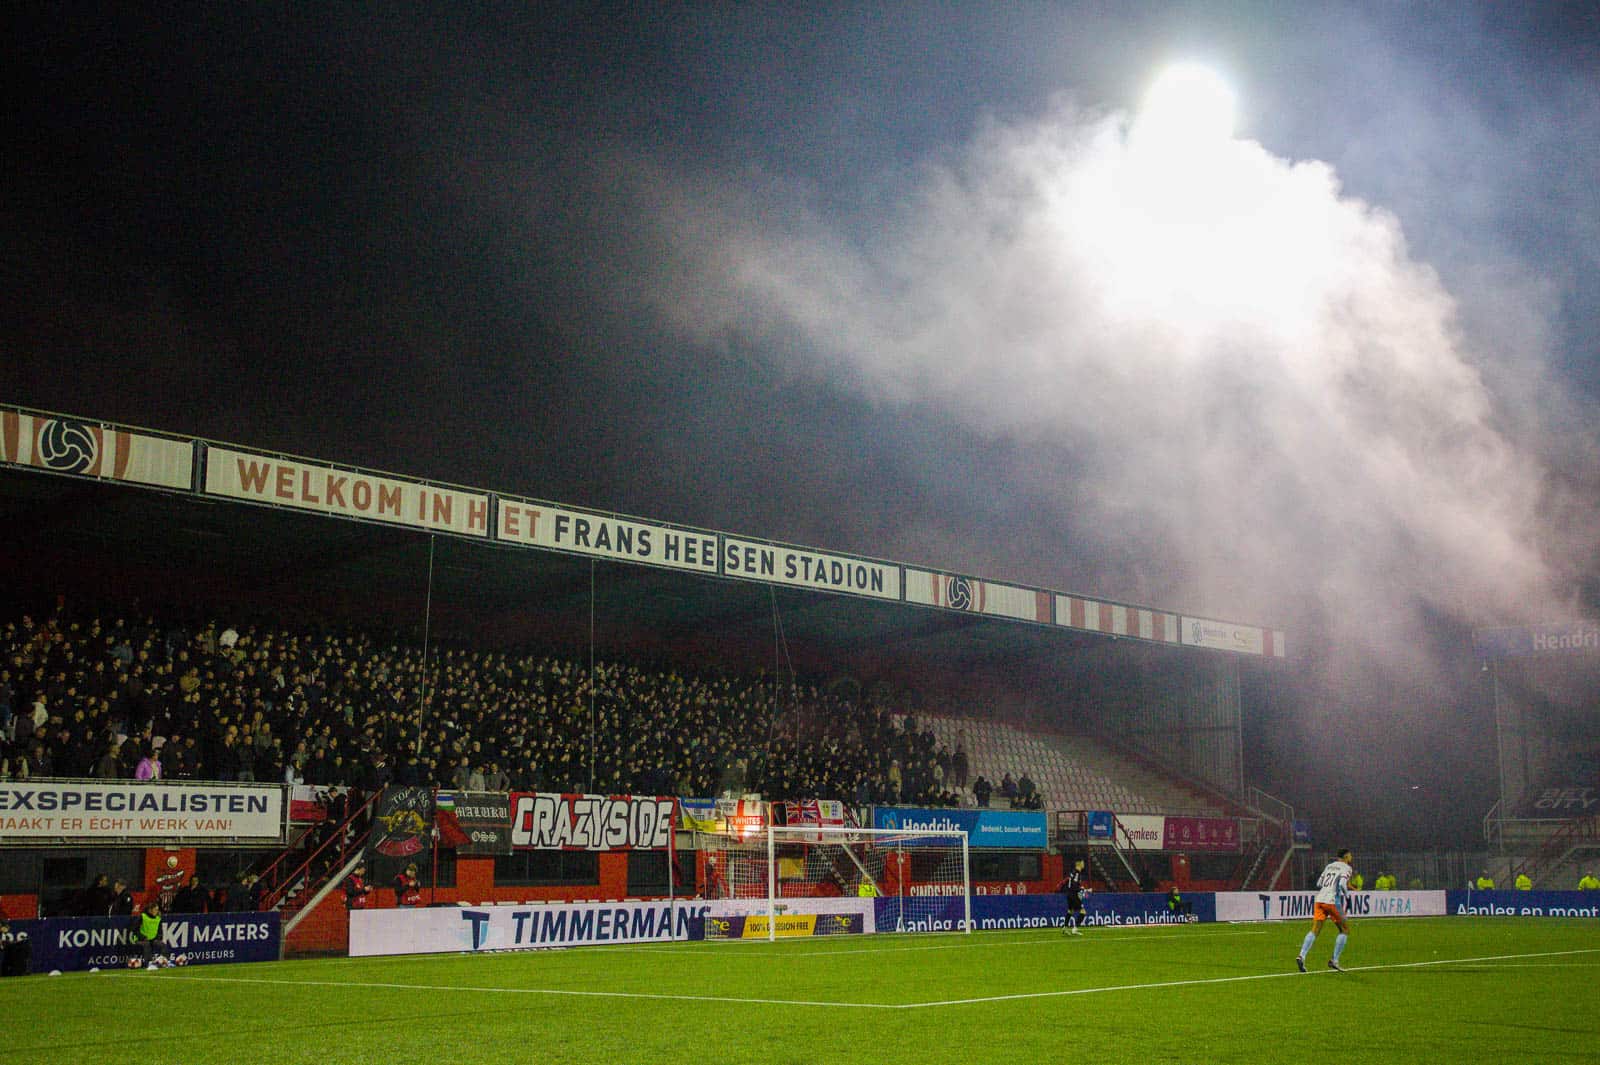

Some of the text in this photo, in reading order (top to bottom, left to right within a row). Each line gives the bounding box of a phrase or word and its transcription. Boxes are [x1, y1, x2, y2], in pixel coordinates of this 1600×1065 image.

[237, 457, 884, 593] WELKOM IN HET FRANS HEESEN STADION
[0, 790, 268, 813] EXSPECIALISTEN
[455, 806, 508, 818] MALUKU
[0, 815, 232, 831] AAKT ER ÉCHT WERK VAN!
[512, 799, 674, 848] CRAZYSIDE
[1323, 872, 1338, 888] 27
[1279, 894, 1370, 917] TIMMANS
[1375, 897, 1412, 914] INFRA
[1521, 907, 1543, 917] en
[193, 923, 270, 943] MATERS
